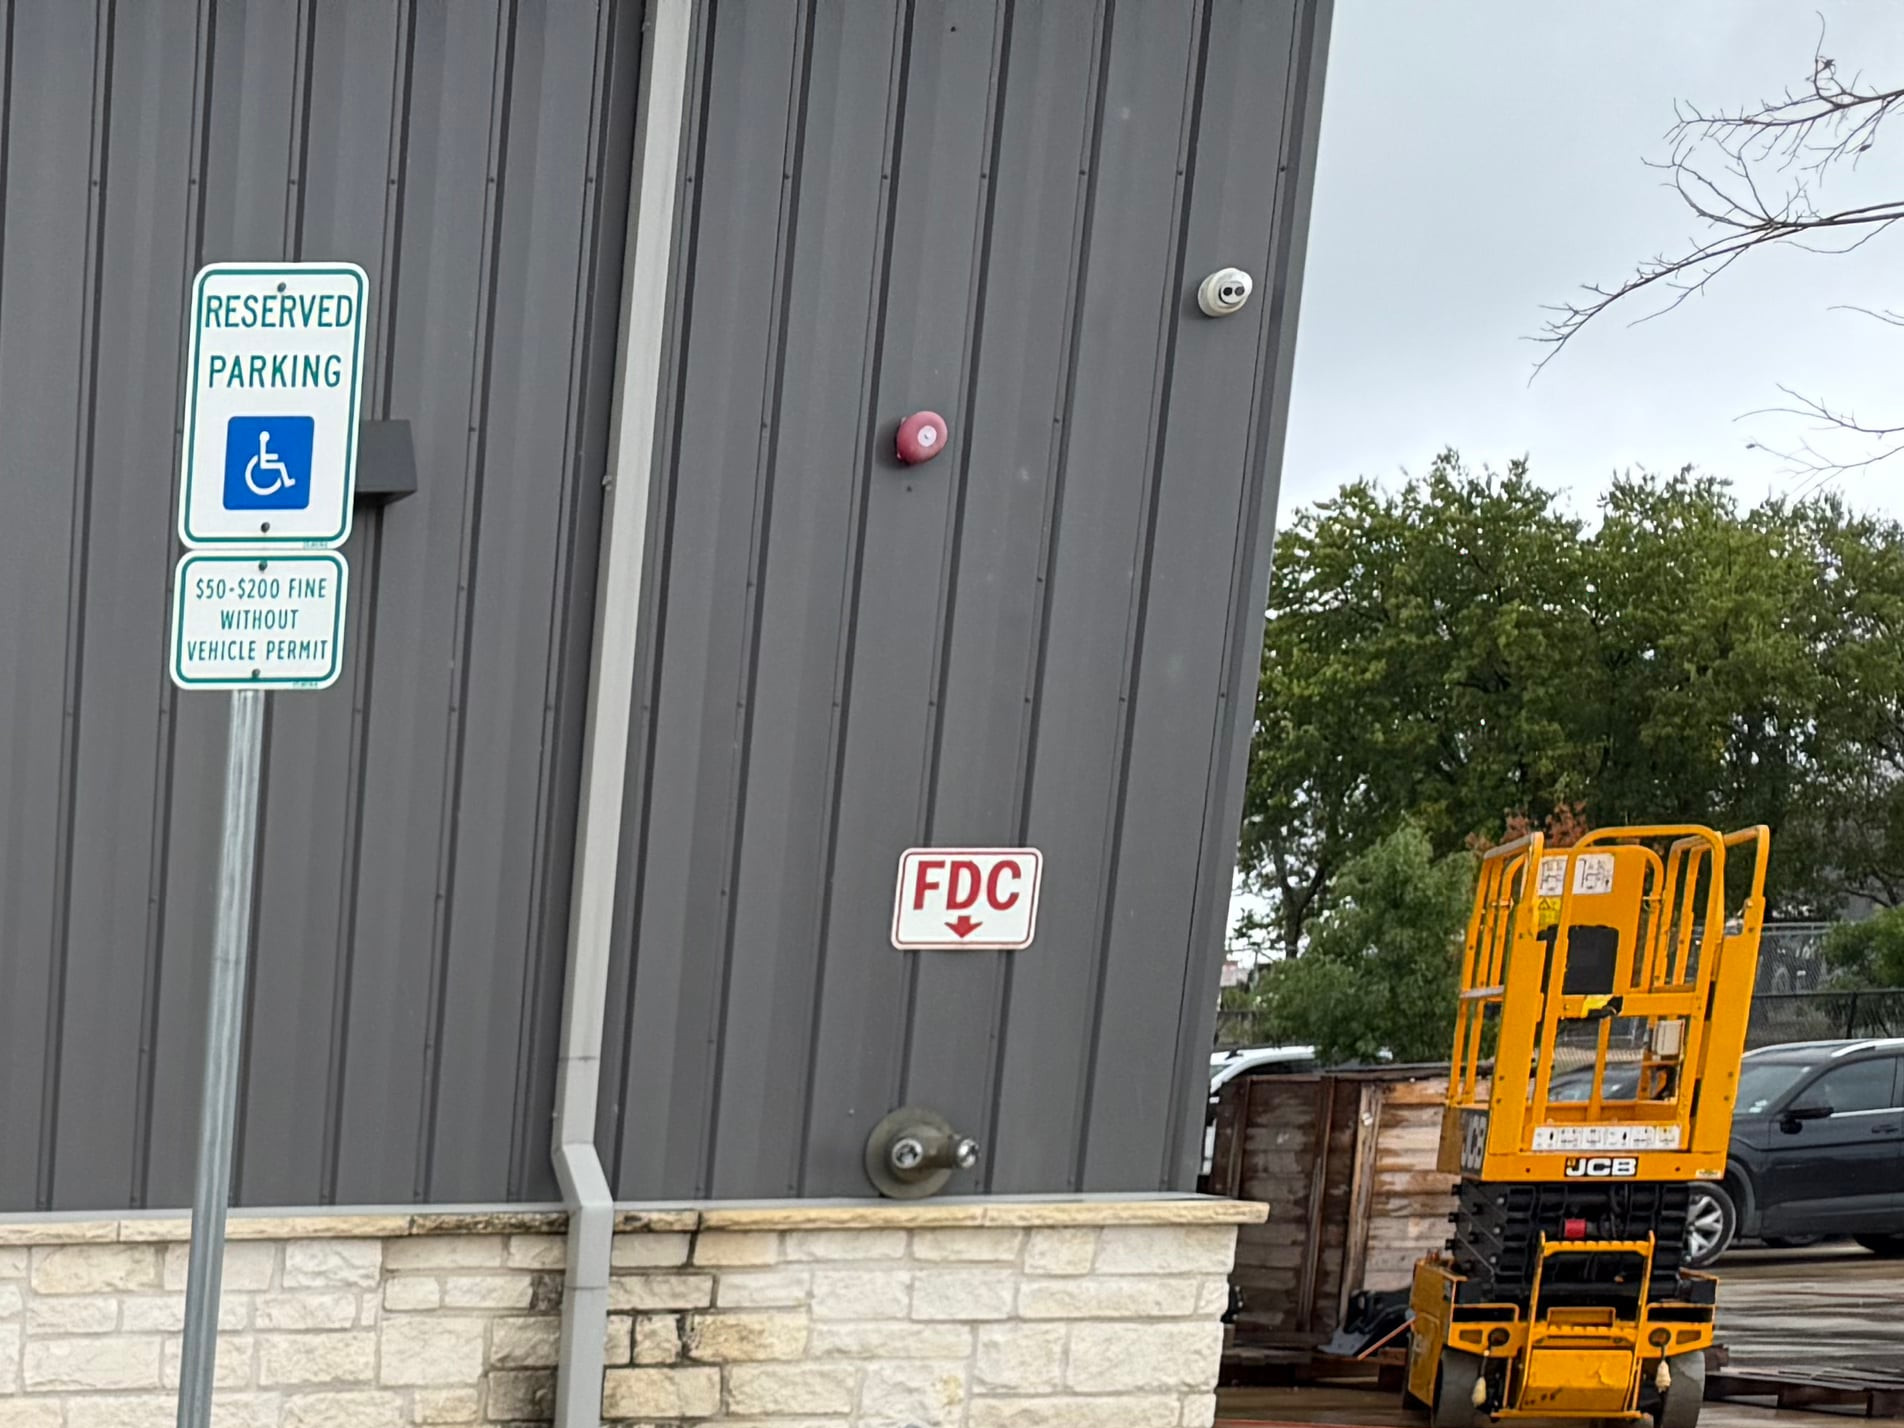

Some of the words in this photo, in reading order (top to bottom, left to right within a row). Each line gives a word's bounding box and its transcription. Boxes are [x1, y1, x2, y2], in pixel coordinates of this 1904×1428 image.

[204, 294, 354, 329] RESERVED
[207, 354, 343, 389] PARKING
[195, 577, 281, 600] $50-$200
[288, 577, 328, 599] FINE
[220, 608, 300, 630] WITHOUT
[187, 640, 257, 662] VEHICLE
[265, 639, 329, 661] PERMIT
[912, 859, 1022, 911] FDC
[1565, 1157, 1638, 1178] JCB
